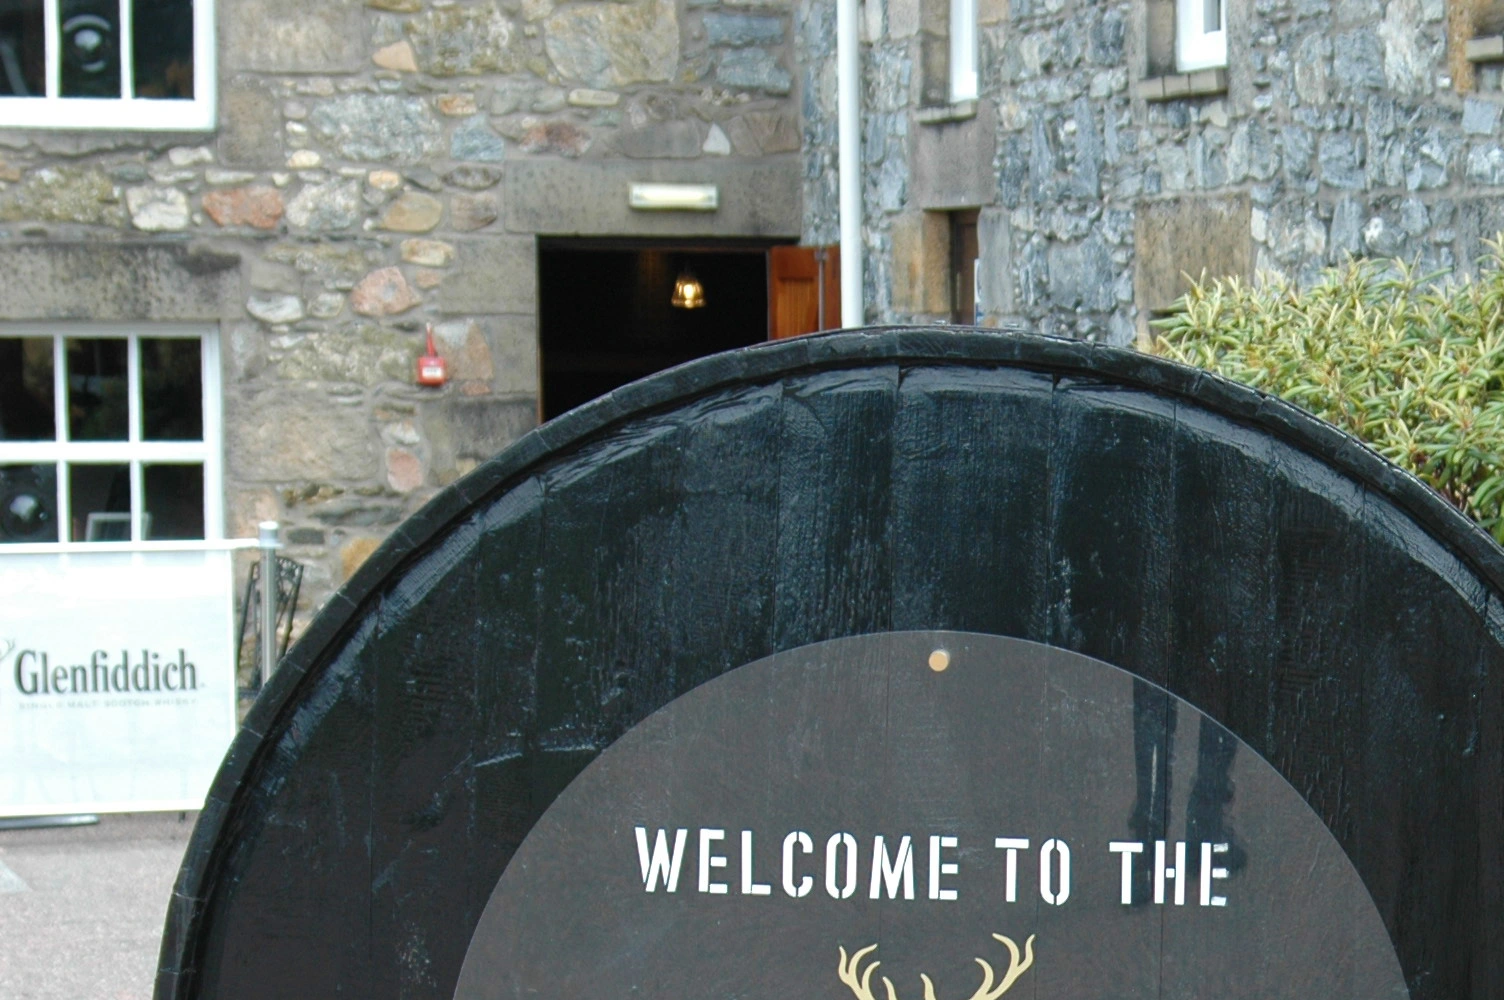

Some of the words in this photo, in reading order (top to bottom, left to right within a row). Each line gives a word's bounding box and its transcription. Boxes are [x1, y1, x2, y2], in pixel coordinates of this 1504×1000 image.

[14, 648, 198, 696] Glenfiddich
[635, 827, 957, 900] WELCOME
[995, 838, 1069, 905] TO
[1110, 841, 1228, 906] THE
